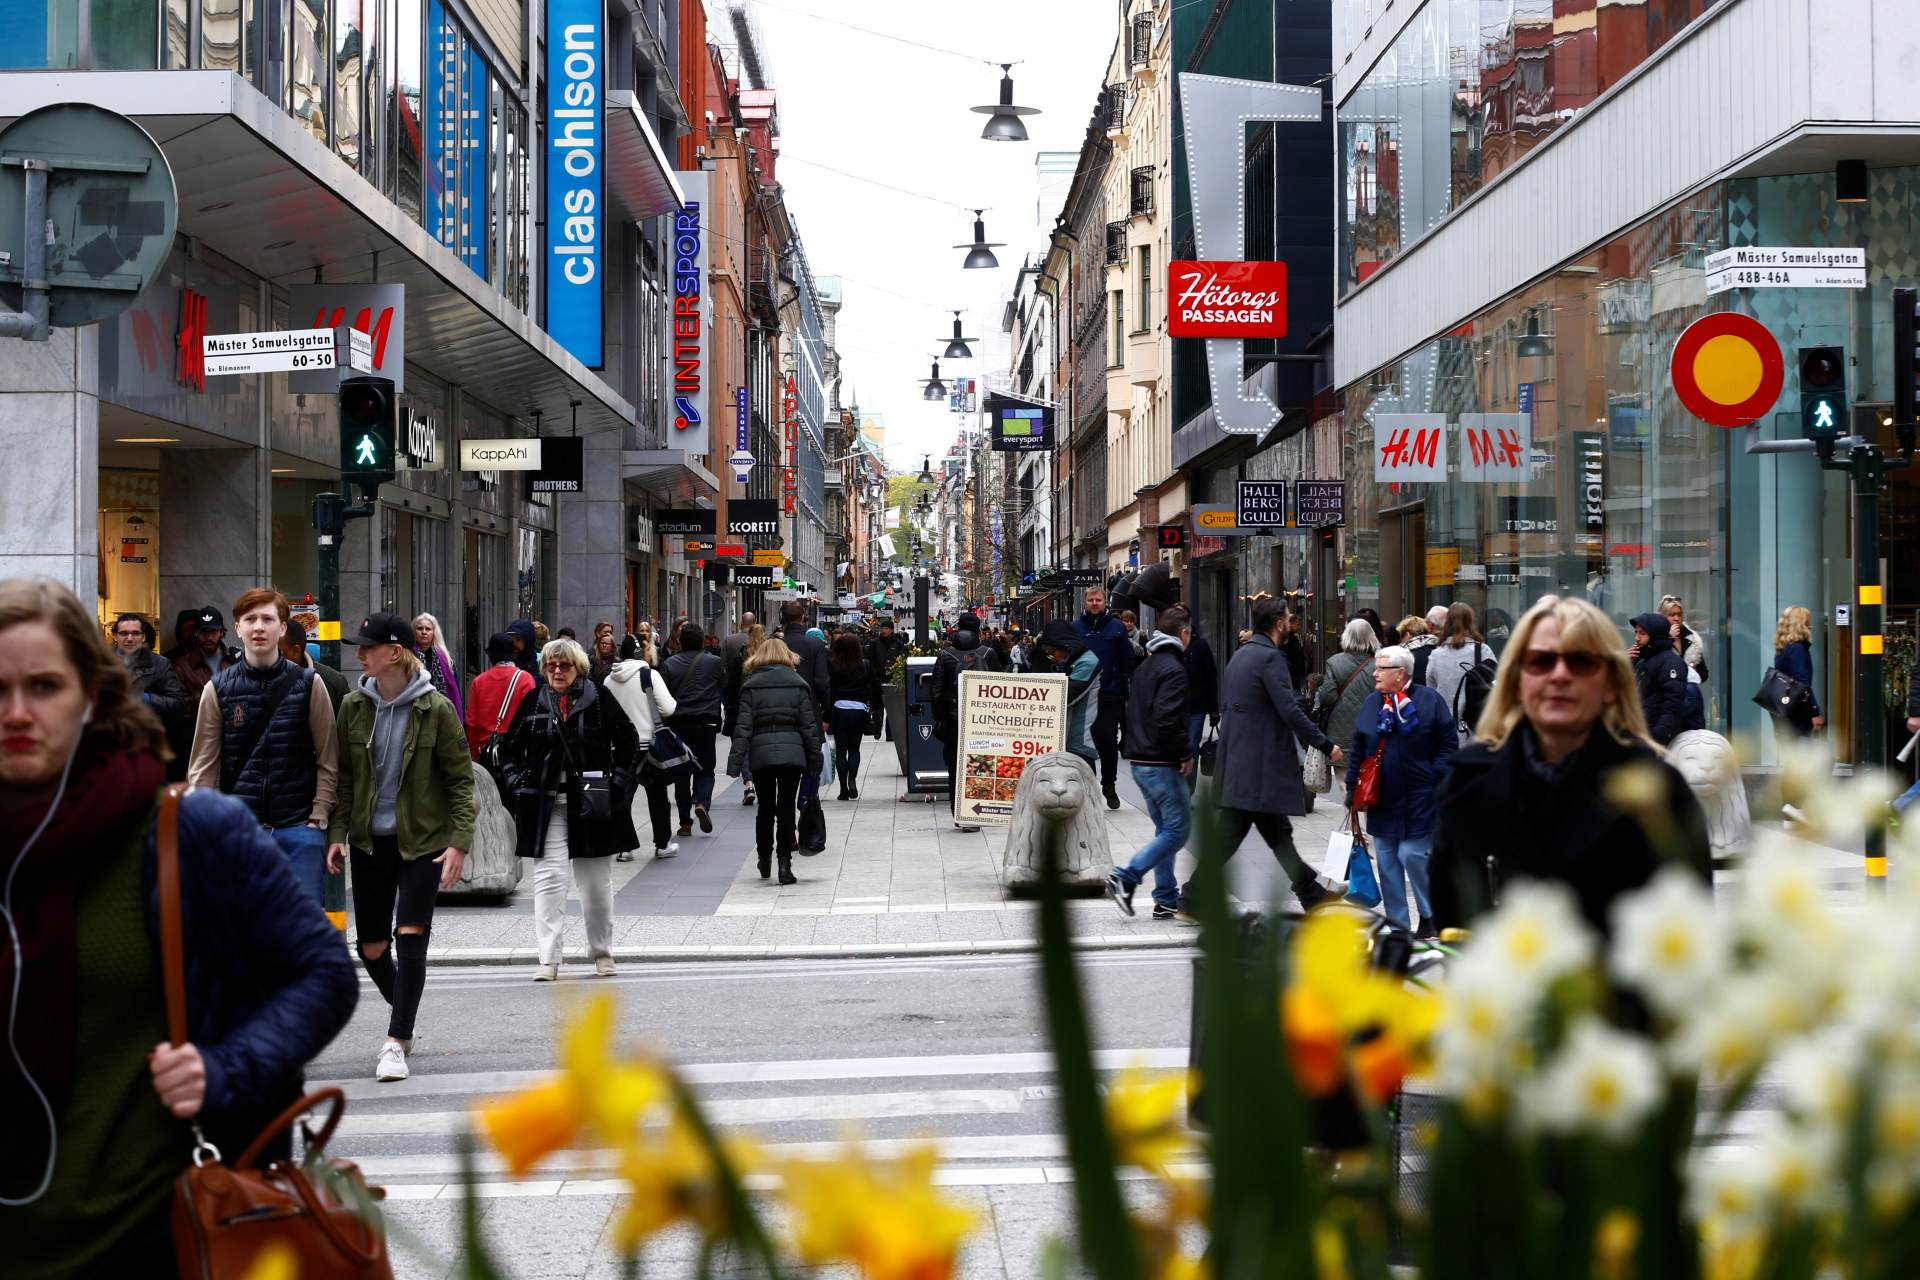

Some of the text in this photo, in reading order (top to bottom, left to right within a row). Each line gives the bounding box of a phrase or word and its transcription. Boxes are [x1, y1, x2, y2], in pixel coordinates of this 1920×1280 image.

[554, 24, 595, 285] clas ohlson
[1737, 251, 1858, 266] Mäster Samuelsgatan
[1738, 271, 1790, 284] 48B-46A
[675, 201, 700, 391] INTERSPORT
[1178, 272, 1280, 310] Hötorgs
[1182, 309, 1273, 323] PASSAGEN
[207, 334, 331, 352] Mäster Samuelsgatan
[292, 353, 332, 367] 60-50
[408, 407, 436, 469] KappAhl
[785, 375, 798, 515] APOTEK
[1003, 435, 1043, 444] everysport
[471, 447, 527, 462] KappAhl
[1381, 427, 1441, 469] H&M
[533, 480, 578, 491] BROTHERS
[1243, 486, 1279, 497] HALL
[1243, 499, 1278, 509] BERG
[1243, 511, 1280, 522] GULD
[658, 522, 702, 532] stadium
[729, 521, 777, 533] SCORETT
[736, 576, 771, 585] SCORETT
[978, 685, 1050, 701] HOLIDAY
[970, 701, 1026, 711] RESTAURANT
[1039, 704, 1056, 712] BAR
[972, 714, 1054, 728] LUNCHBUFFÉ
[1012, 740, 1053, 756] 99kr
